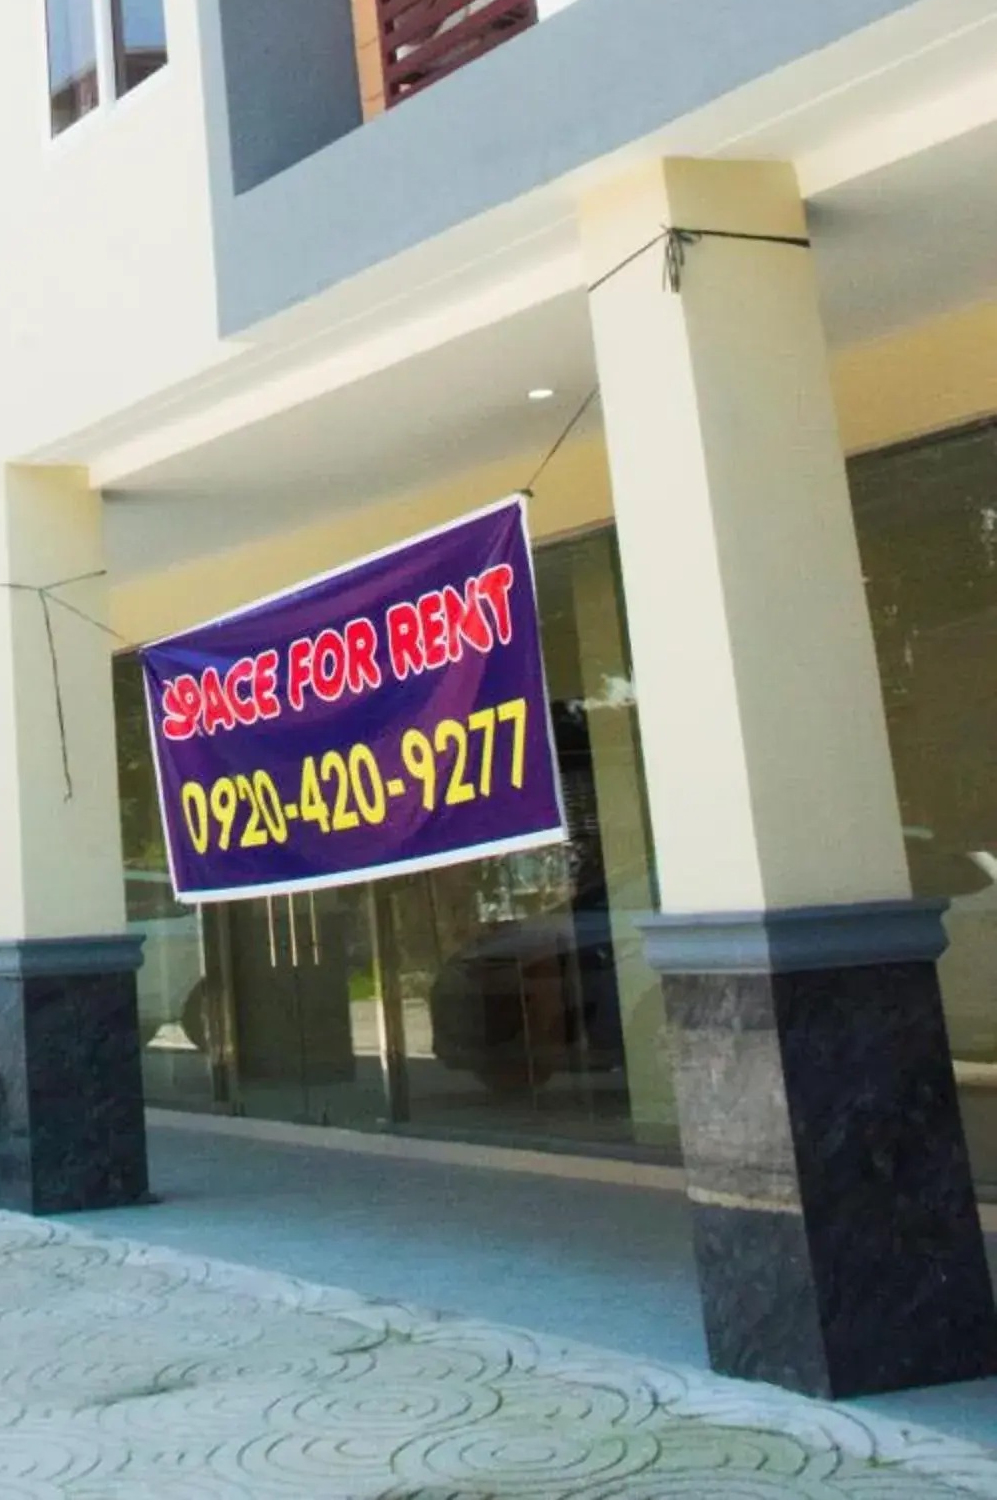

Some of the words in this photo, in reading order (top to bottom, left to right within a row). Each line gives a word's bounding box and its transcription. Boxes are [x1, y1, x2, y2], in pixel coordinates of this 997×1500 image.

[162, 649, 281, 739] SPACE
[288, 617, 381, 710] FOR
[387, 563, 513, 681] RENT
[181, 698, 527, 854] 0920-420-9277
